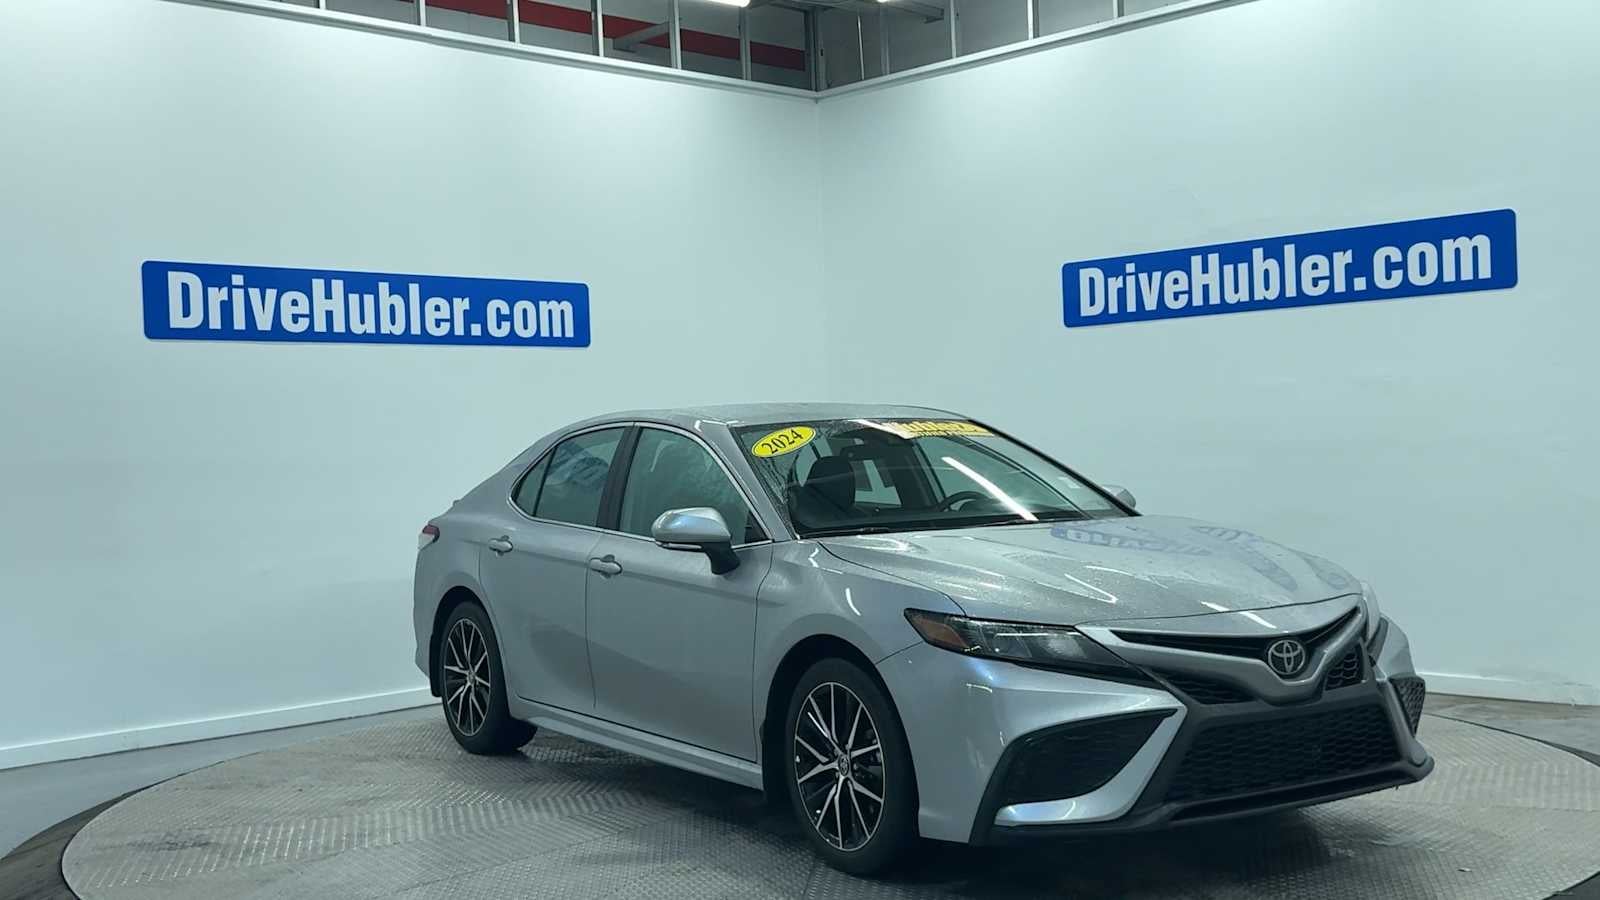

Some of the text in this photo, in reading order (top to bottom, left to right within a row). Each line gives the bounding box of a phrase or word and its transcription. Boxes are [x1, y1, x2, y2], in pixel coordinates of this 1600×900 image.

[167, 270, 575, 338] DriveHubler.com
[1079, 232, 1492, 317] DriveHubler.com
[761, 428, 804, 455] 2024
